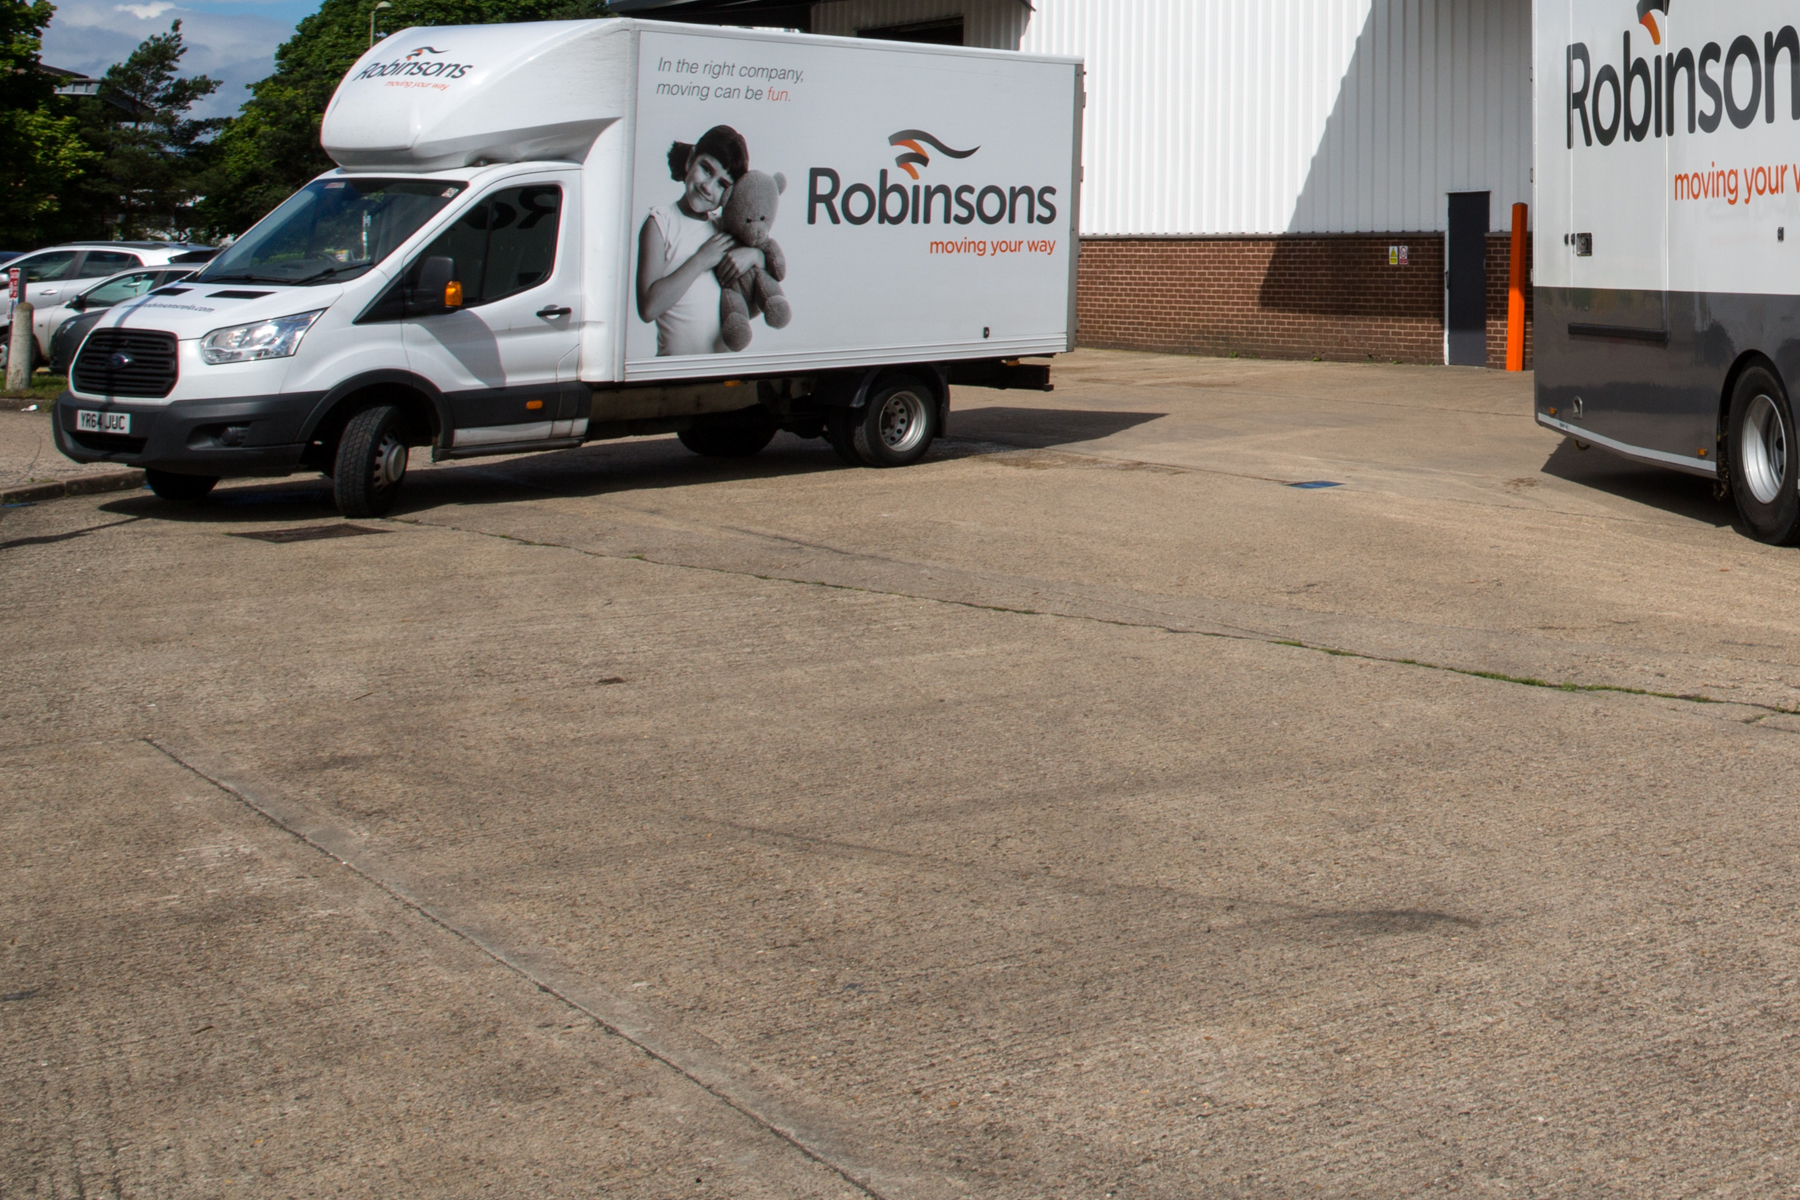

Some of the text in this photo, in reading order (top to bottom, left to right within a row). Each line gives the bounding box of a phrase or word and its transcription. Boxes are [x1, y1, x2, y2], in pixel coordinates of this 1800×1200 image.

[352, 58, 475, 81] Robinsons
[657, 57, 805, 84] In the right company,
[656, 82, 791, 102] moving can be fun.
[1674, 161, 1739, 205] moving
[1743, 164, 1788, 205] your
[807, 167, 1058, 225] Robinsons
[929, 237, 1056, 256] moving your way
